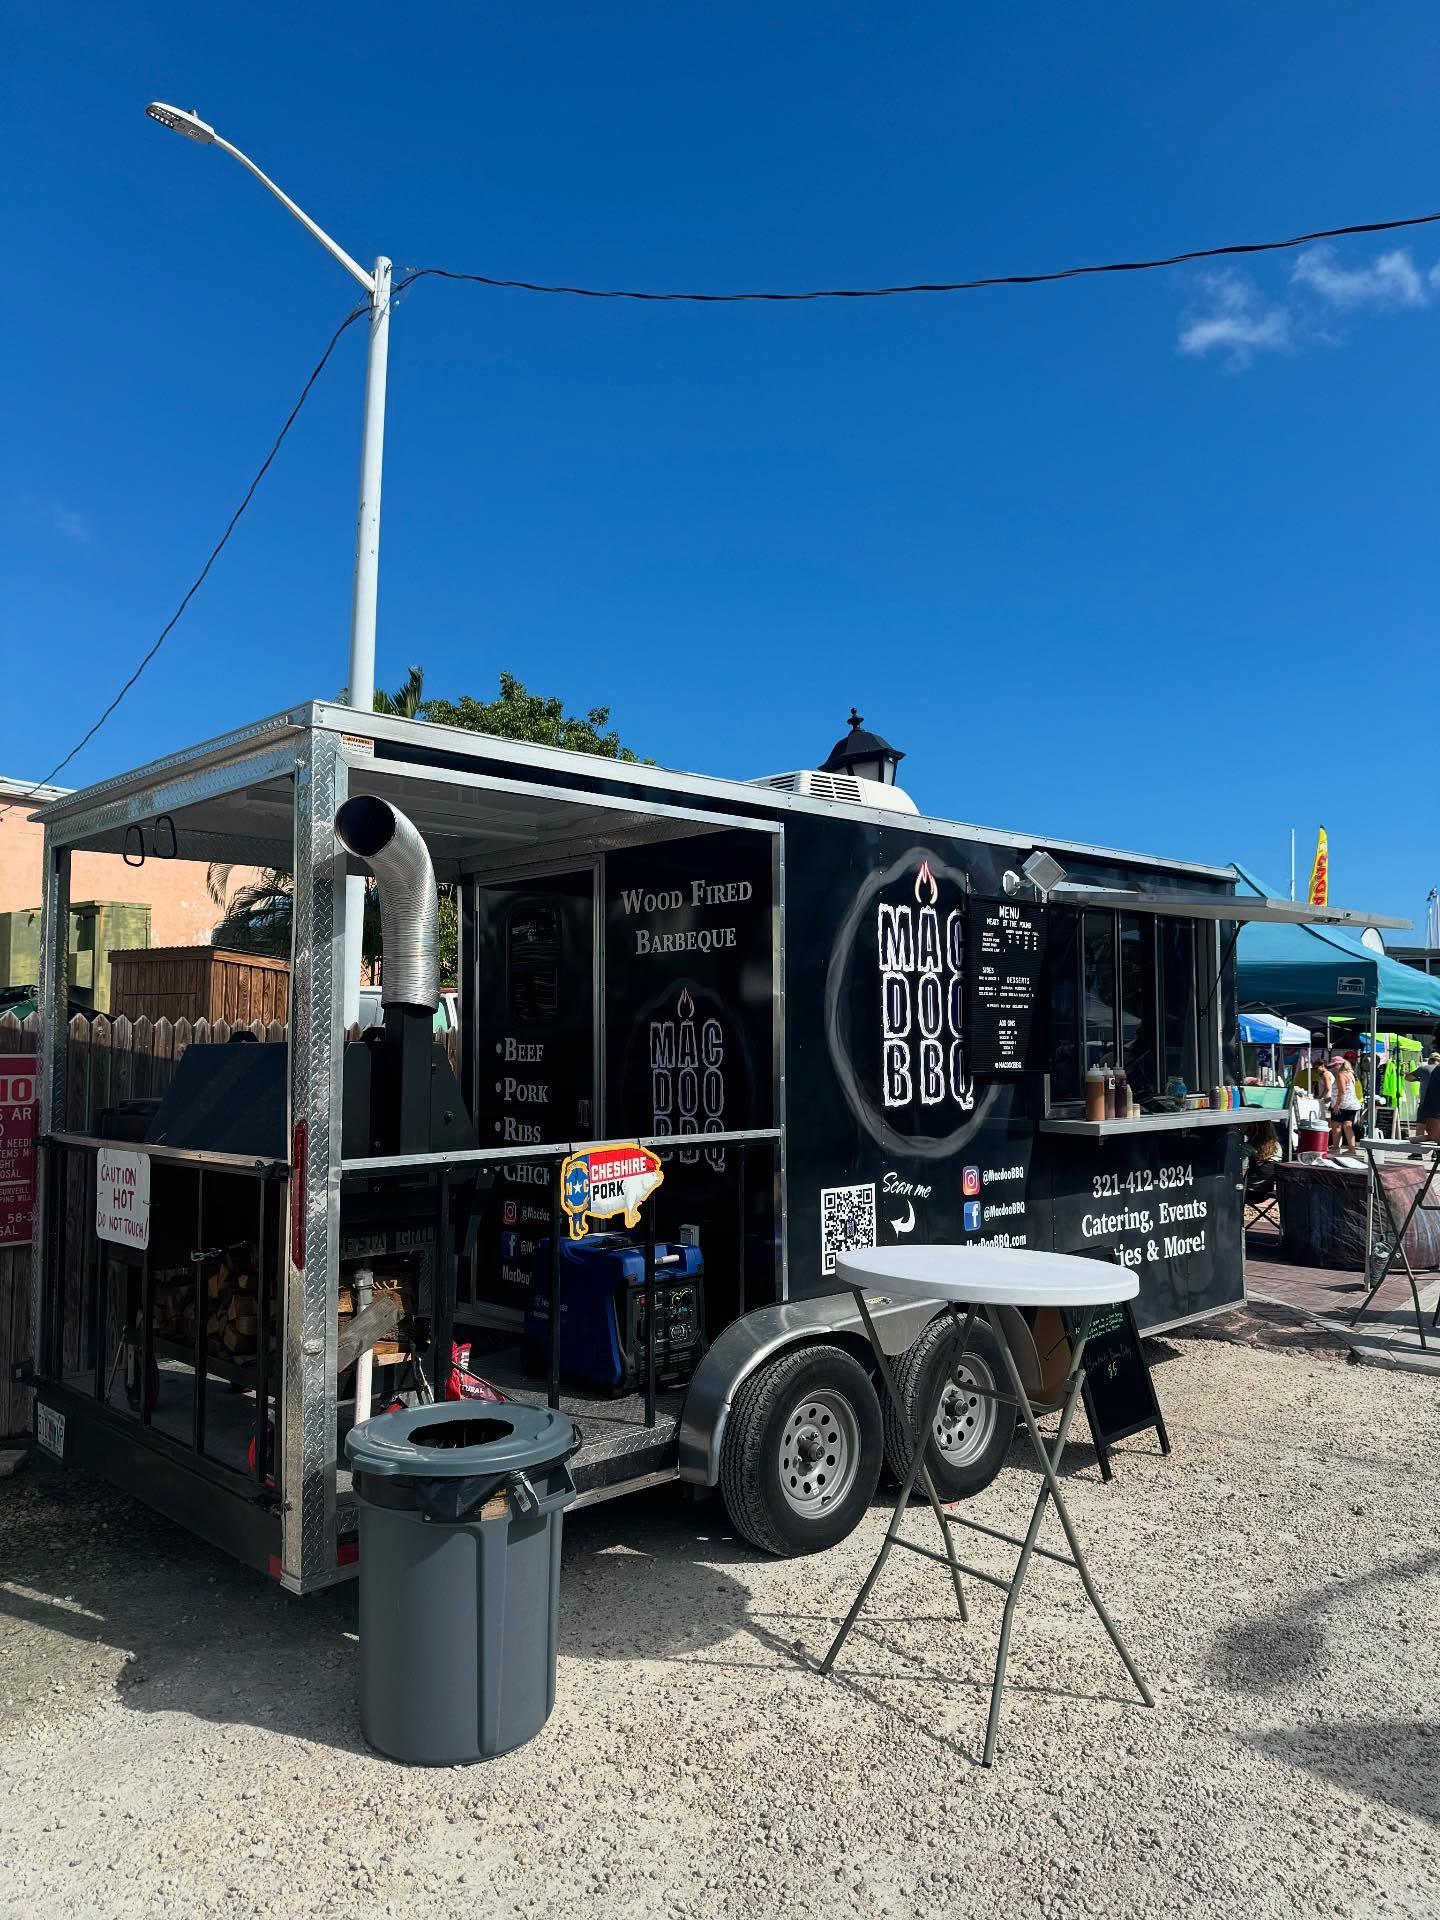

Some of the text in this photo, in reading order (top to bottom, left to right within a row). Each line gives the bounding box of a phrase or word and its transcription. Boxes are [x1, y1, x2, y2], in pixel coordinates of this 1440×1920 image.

[999, 905, 1020, 919] MENU
[635, 927, 737, 955] BARBEQUE
[878, 902, 967, 973] MAC
[882, 971, 967, 1039] DOO
[650, 1018, 724, 1068] MAC
[883, 1038, 974, 1109] BBQ
[653, 1067, 725, 1117] DOO
[100, 1163, 137, 1187] CAUTION
[591, 1157, 647, 1181] CHESHIRE
[983, 1166, 1024, 1185] @MacdooBBQ
[1092, 1164, 1194, 1198] 321-412-8234
[112, 1187, 135, 1211] HOT
[592, 1180, 625, 1201] PORK
[882, 1171, 932, 1199] Scan me
[97, 1210, 106, 1228] DO
[109, 1216, 122, 1232] NOT
[983, 1201, 1026, 1221] @MacdooBBQ
[1081, 1199, 1207, 1238] Catering, Events
[1146, 1239, 1160, 1262] &
[1163, 1230, 1206, 1259] More!
